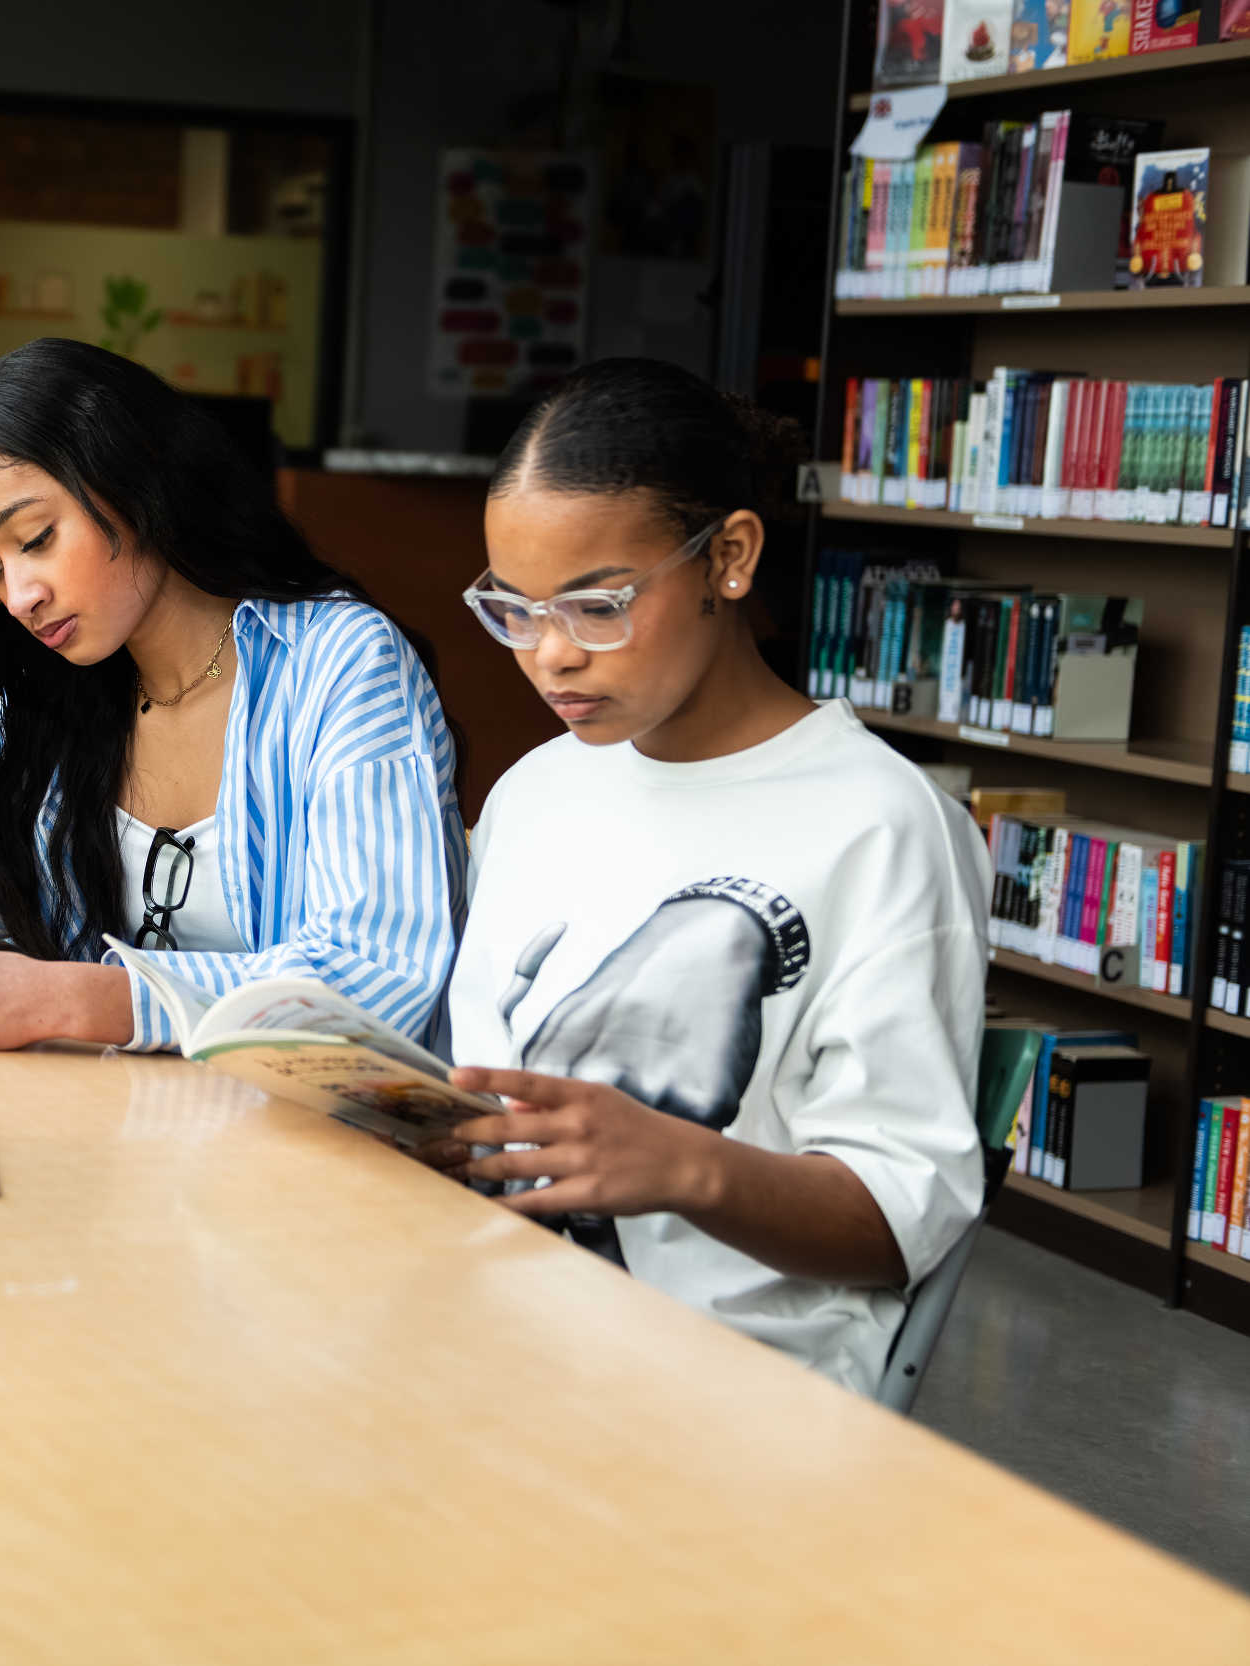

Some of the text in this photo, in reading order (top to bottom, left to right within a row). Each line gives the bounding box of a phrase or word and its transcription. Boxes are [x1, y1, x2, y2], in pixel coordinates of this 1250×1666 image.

[802, 467, 821, 495] A
[893, 683, 913, 715] B
[1101, 950, 1125, 982] C
